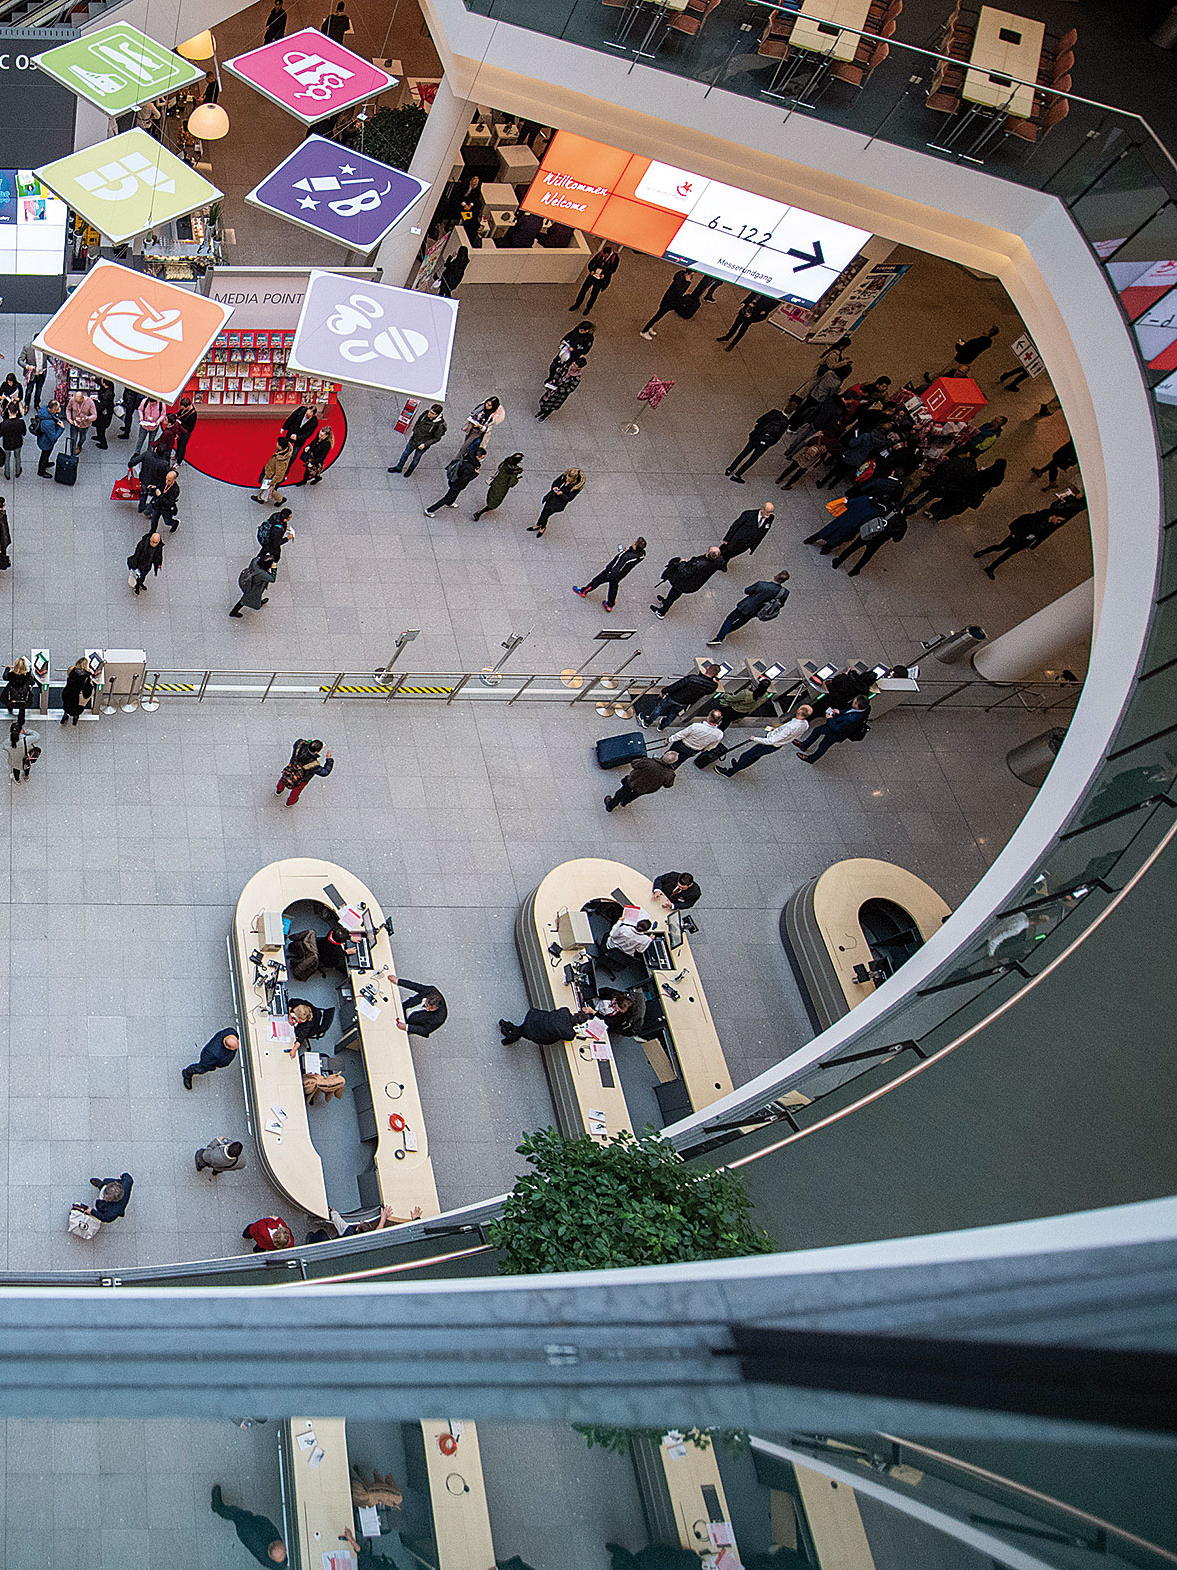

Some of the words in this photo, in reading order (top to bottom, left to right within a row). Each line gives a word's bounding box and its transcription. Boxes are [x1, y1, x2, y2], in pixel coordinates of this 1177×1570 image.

[543, 172, 609, 196] Willkommen
[540, 191, 588, 212] Welcome
[717, 258, 773, 283] Messerundgang
[214, 293, 259, 304] MEDIA
[263, 293, 305, 304] POINT
